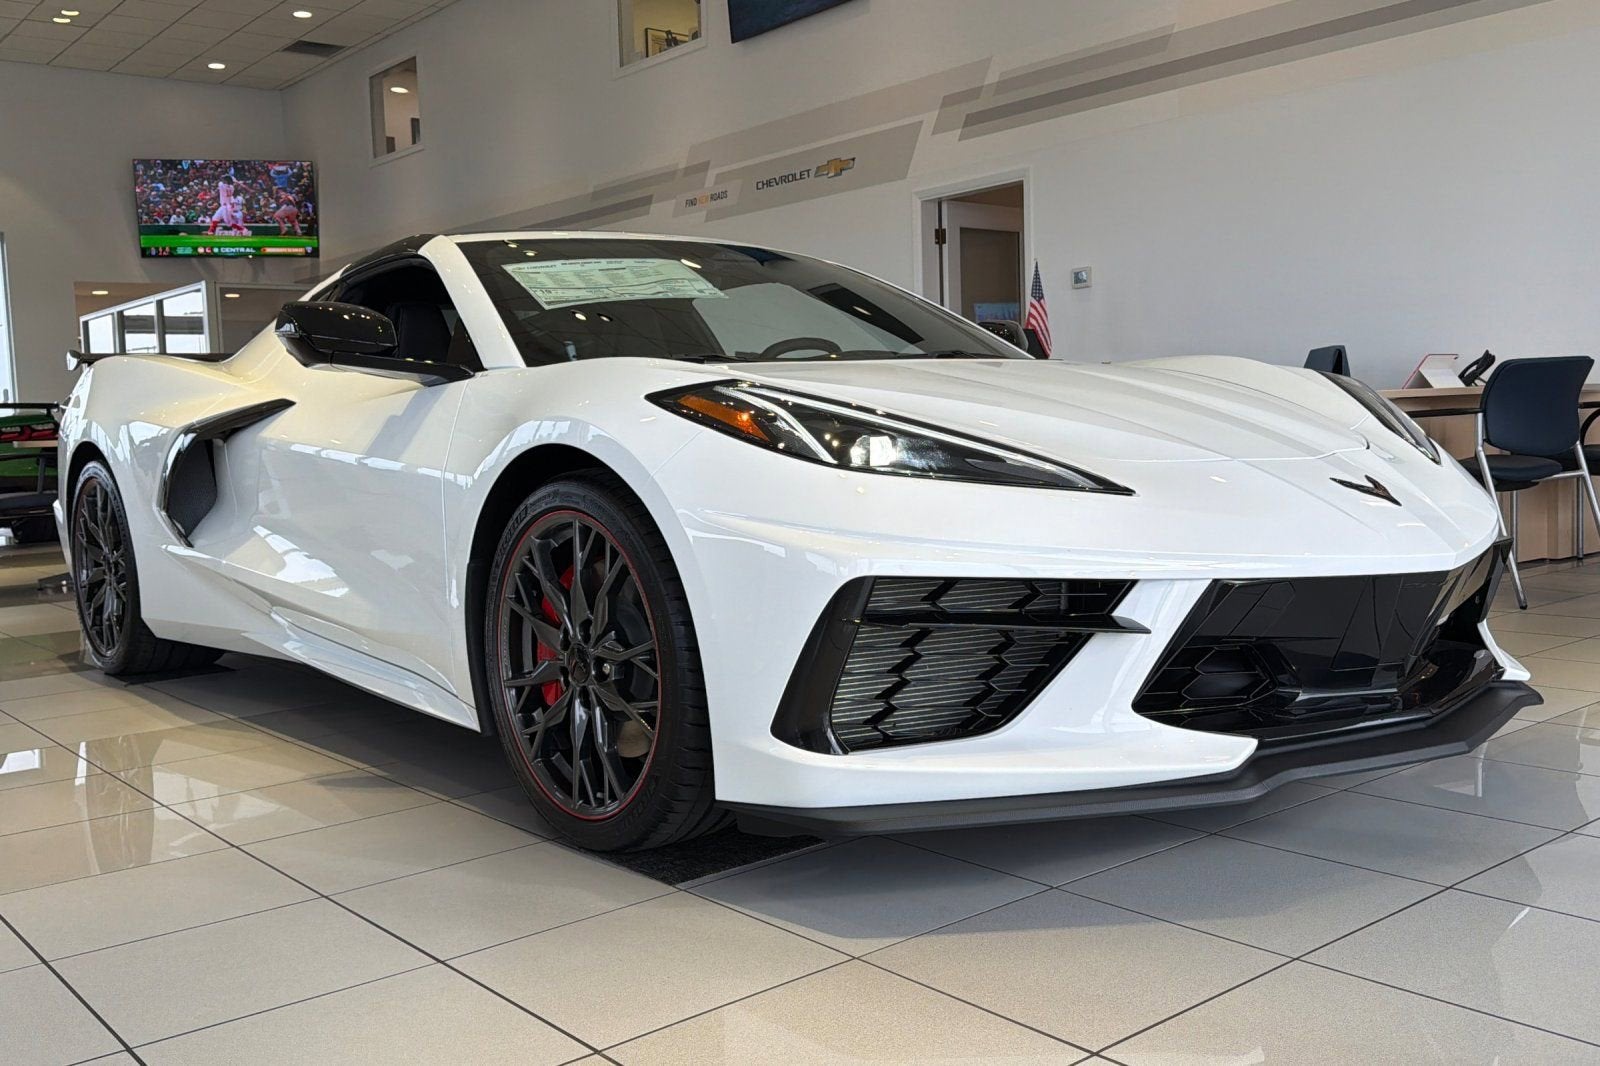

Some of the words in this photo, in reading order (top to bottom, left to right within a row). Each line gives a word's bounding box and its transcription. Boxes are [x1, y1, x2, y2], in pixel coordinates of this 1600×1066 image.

[755, 168, 812, 191] CHEVROLET
[684, 197, 697, 208] FIND
[709, 189, 728, 202] ROADS
